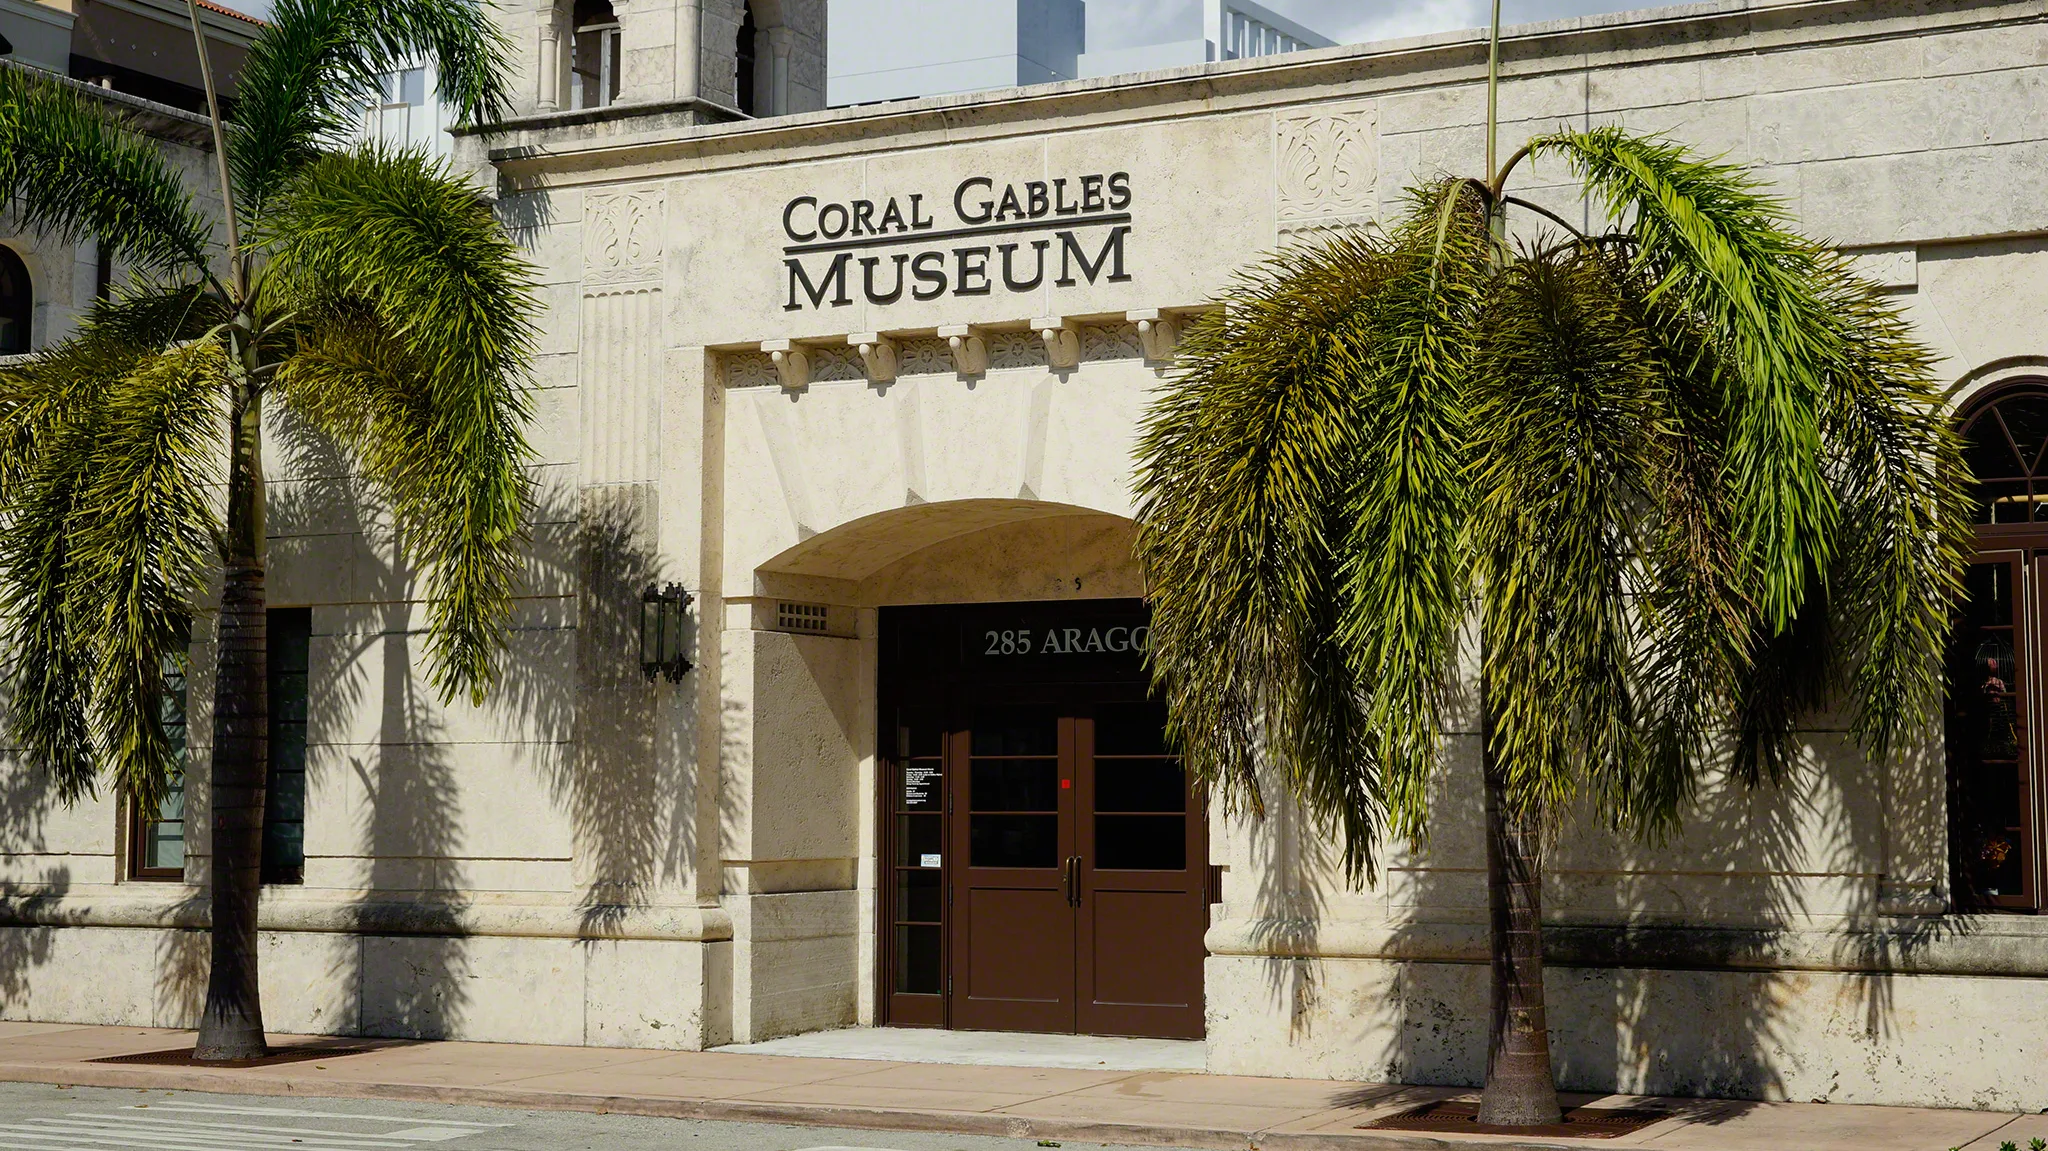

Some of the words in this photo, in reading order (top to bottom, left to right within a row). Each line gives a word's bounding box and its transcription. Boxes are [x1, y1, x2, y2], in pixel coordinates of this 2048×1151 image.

[782, 194, 933, 243] CORAL
[954, 171, 1132, 225] GABLES
[782, 226, 1132, 312] MUSEUM
[984, 629, 1032, 655] 285
